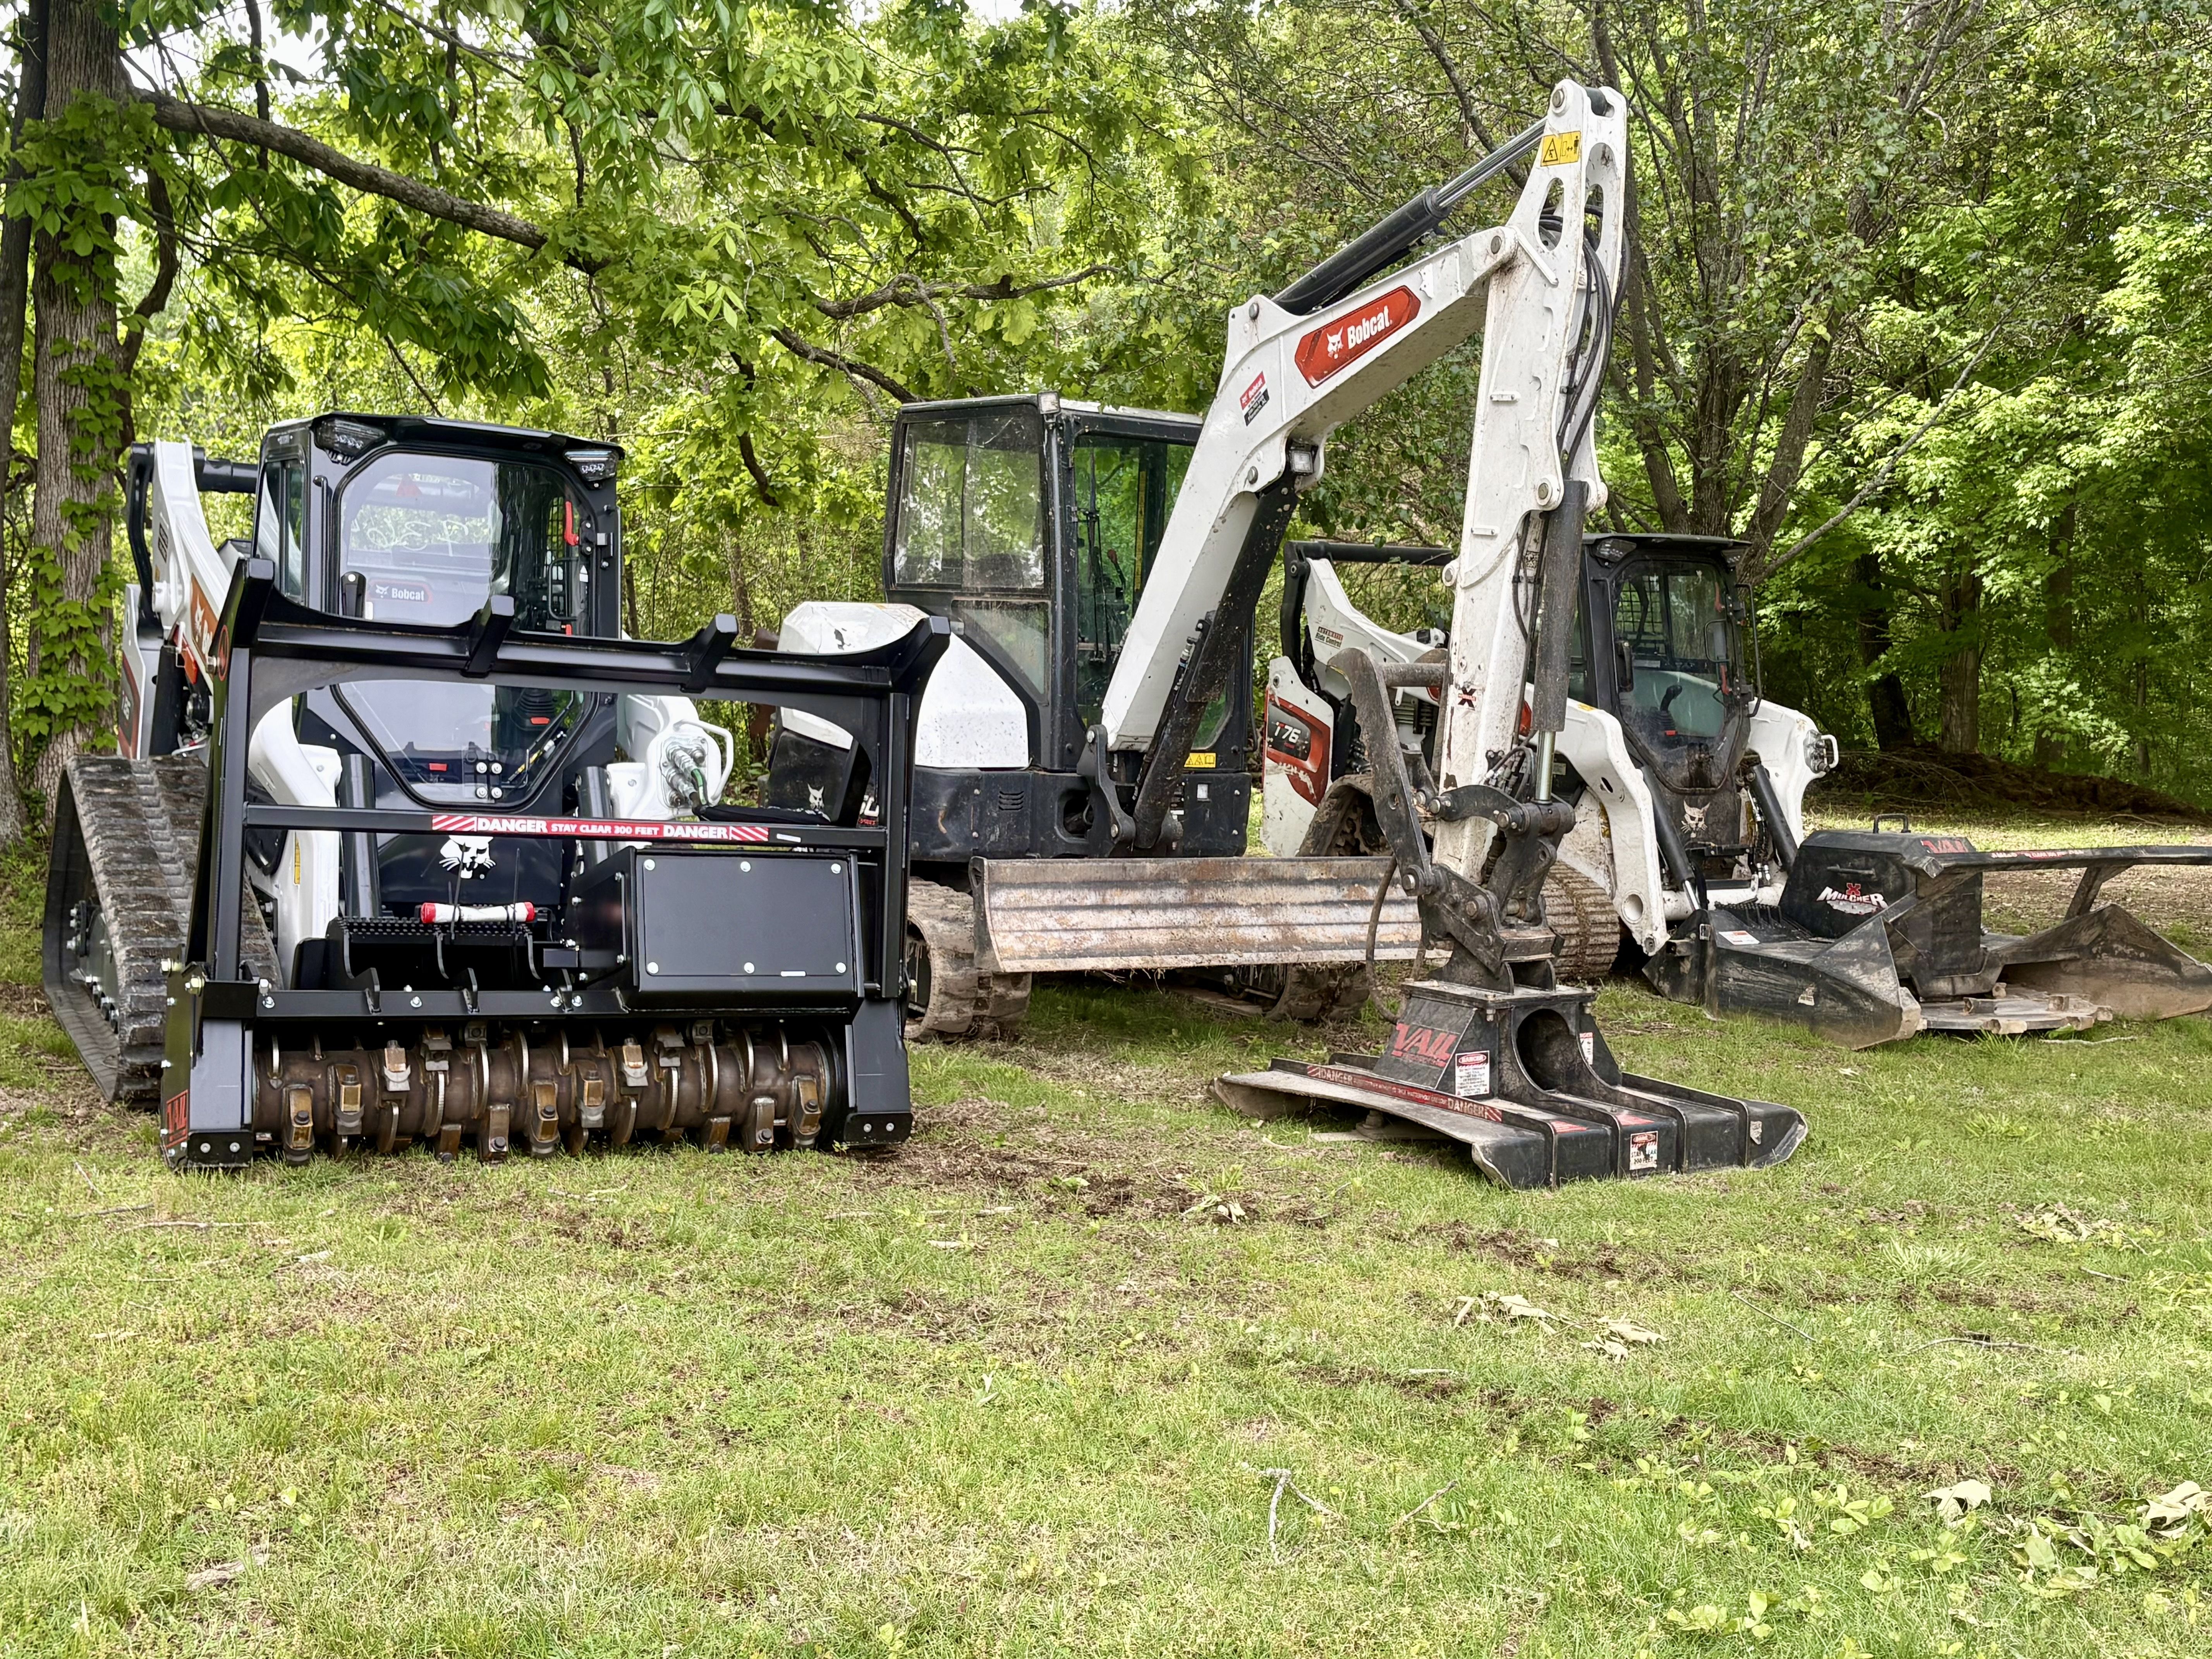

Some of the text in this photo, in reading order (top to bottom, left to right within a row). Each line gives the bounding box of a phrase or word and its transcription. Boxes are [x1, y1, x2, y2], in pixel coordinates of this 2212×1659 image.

[1347, 305, 1390, 349] Bobcat
[392, 587, 424, 601] Bobcat
[1274, 721, 1301, 744] T76
[477, 817, 729, 839] DANGER STAY CLEAR 300 FEET DANGER
[1816, 886, 1889, 909] MULCHER
[1395, 1023, 1458, 1060] VAIL
[1320, 1068, 1353, 1084] DANGER
[1447, 1098, 1485, 1118] DANGER
